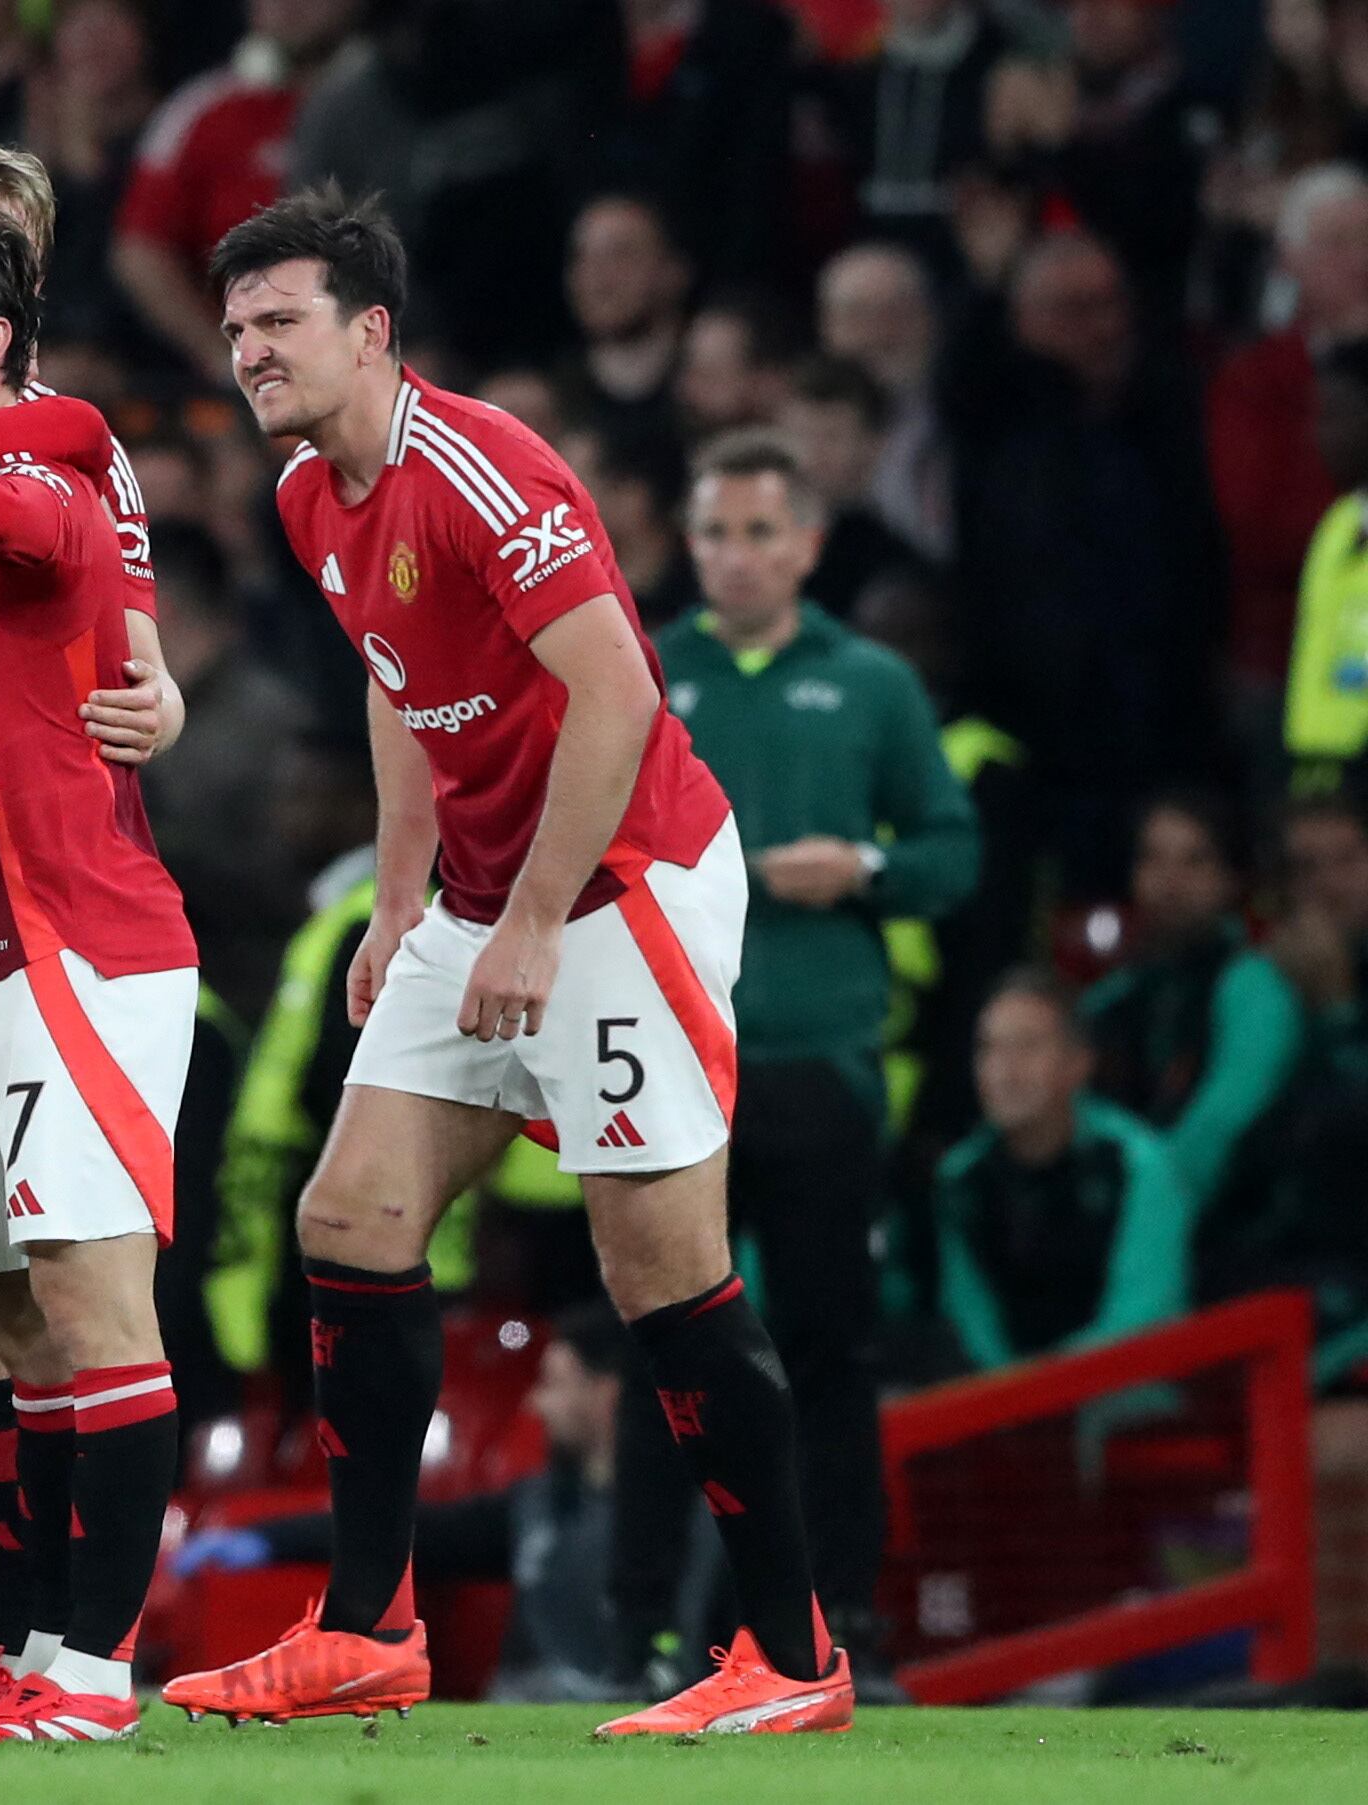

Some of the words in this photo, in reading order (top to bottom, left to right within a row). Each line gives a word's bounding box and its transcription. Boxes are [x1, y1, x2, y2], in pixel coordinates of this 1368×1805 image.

[497, 502, 587, 583] DXC
[519, 540, 593, 593] TECHNOLOGY
[396, 693, 498, 734] dragon
[596, 1017, 645, 1104] 5
[6, 1081, 46, 1172] 7
